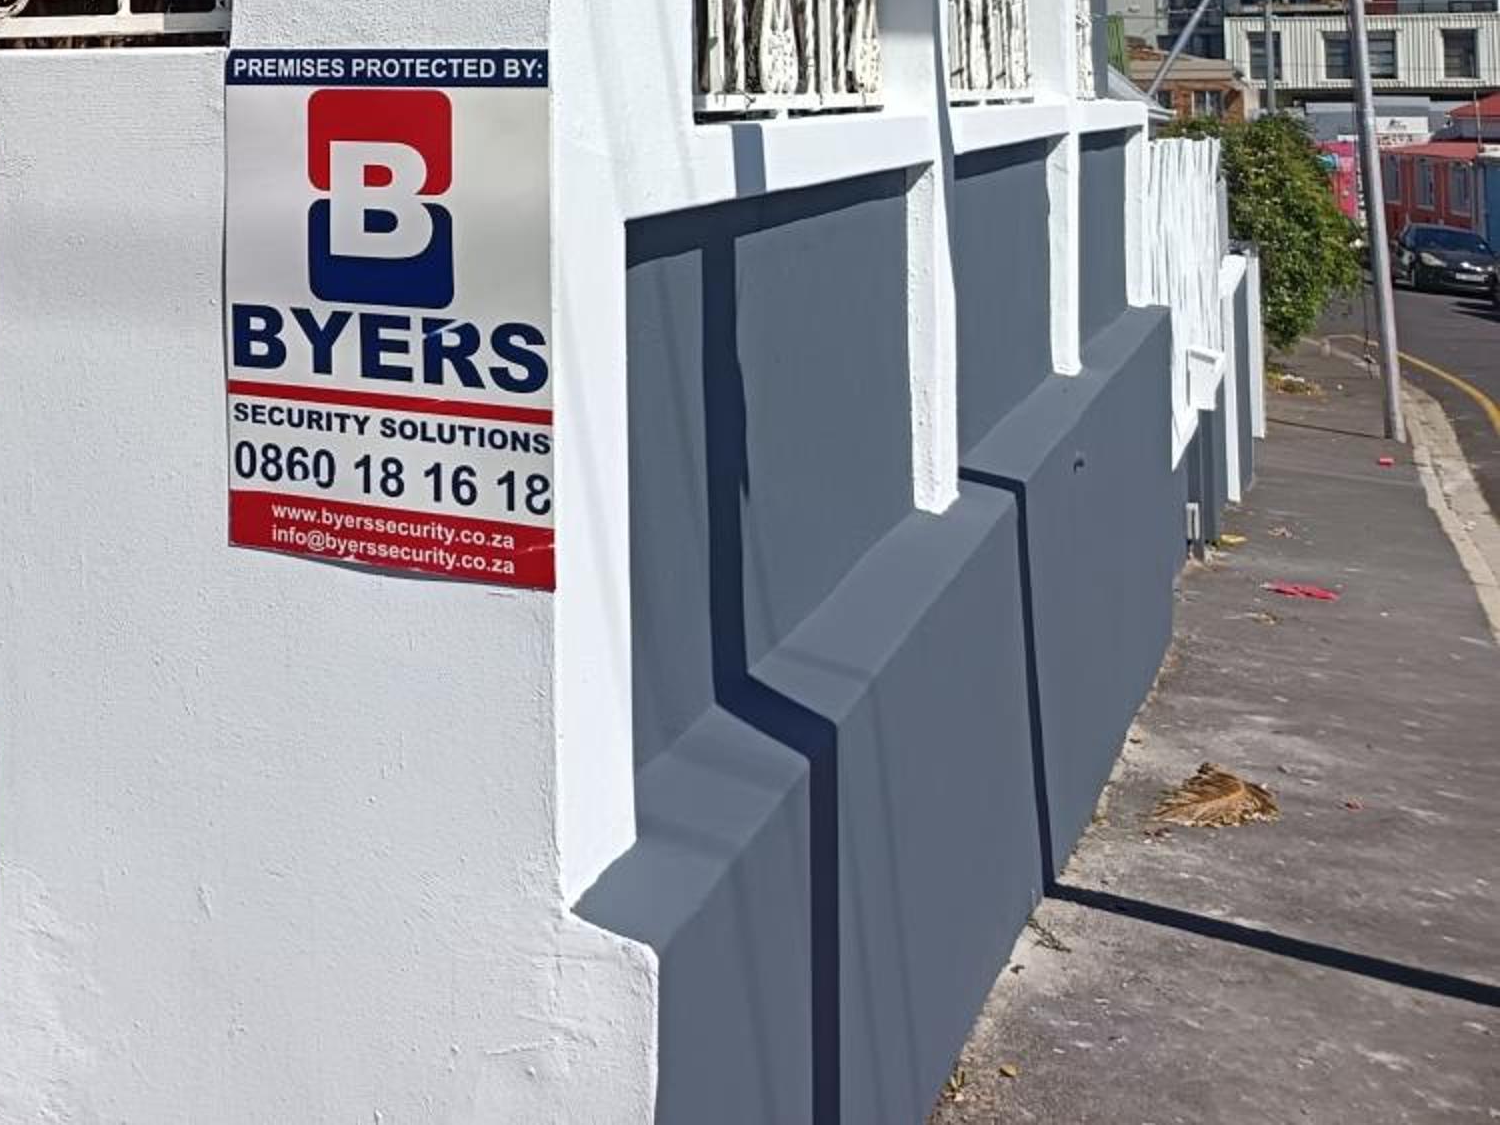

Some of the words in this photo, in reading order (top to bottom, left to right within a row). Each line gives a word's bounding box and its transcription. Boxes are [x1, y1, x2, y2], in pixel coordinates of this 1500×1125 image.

[234, 58, 344, 77] PREMISES
[352, 58, 495, 79] PROTECTED
[503, 59, 544, 79] BY:
[329, 140, 434, 260] B
[231, 303, 549, 394] BYERS
[233, 402, 370, 436] SECURITY
[379, 417, 551, 455] SOLUTIONS
[234, 440, 337, 489] 0860
[354, 454, 405, 498] 18
[423, 462, 478, 506] 16
[497, 470, 551, 515] 18
[271, 504, 515, 551] www.byerssecurity.co.za
[271, 524, 515, 574] info@byerssecurity.co.za
